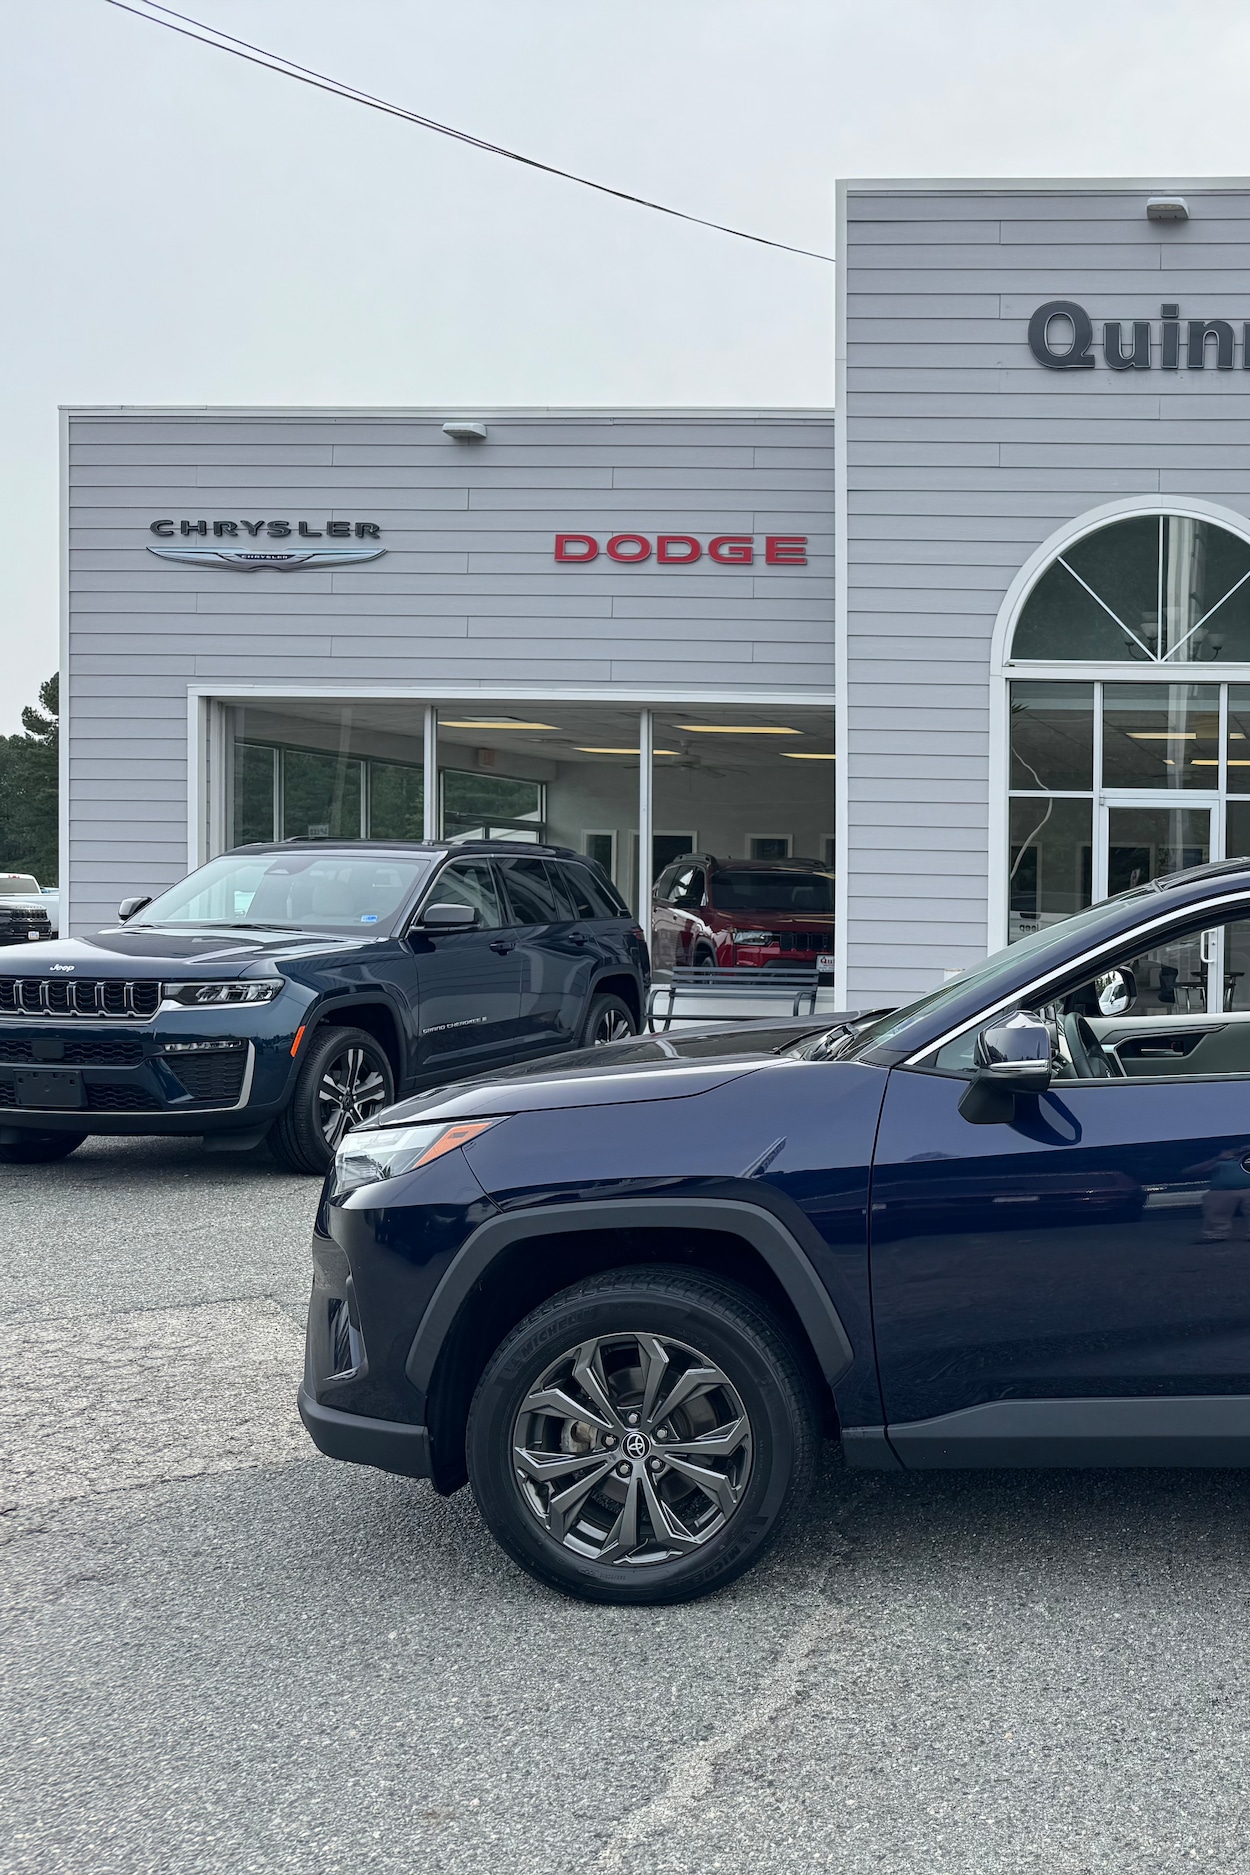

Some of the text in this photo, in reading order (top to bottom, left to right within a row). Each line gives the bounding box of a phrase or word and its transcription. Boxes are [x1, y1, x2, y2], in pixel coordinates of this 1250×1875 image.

[150, 519, 381, 539] CHRYSLER
[554, 534, 809, 565] DODGE
[49, 963, 75, 973] Jeep
[521, 1306, 599, 1358] MICHELIN
